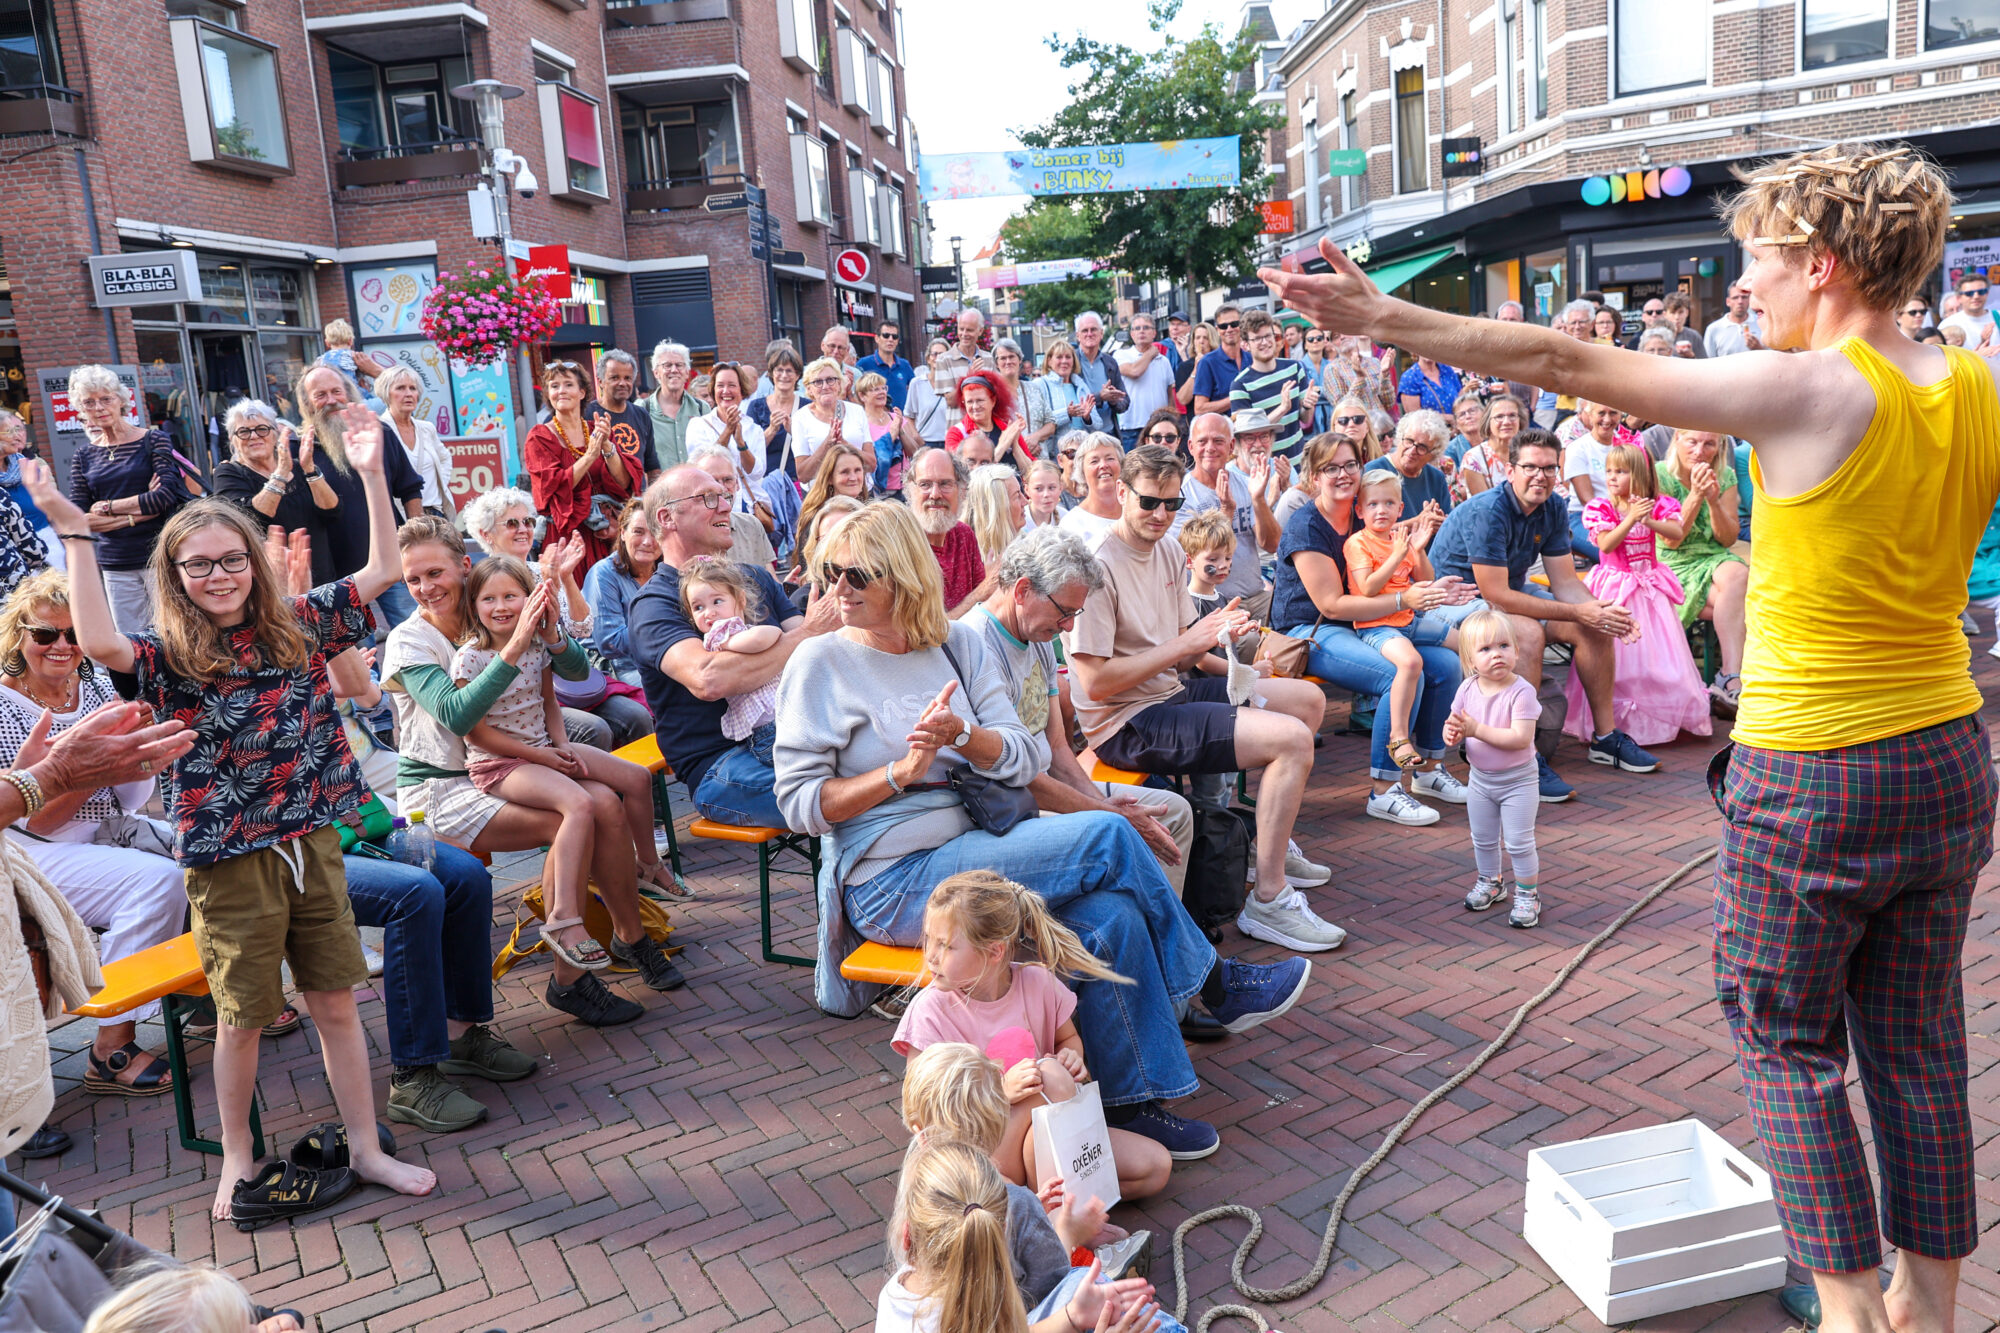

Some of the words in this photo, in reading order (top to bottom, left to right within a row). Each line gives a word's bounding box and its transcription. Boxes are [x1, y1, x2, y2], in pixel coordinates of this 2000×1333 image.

[1032, 152, 1090, 168] Zomer
[1097, 147, 1124, 168] bij
[104, 267, 173, 282] BLA-BLA
[521, 266, 566, 283] jamin
[105, 281, 176, 294] CLASSICS
[922, 283, 940, 291] GERRY
[447, 443, 498, 456] ORTING
[449, 465, 494, 495] 50
[1072, 1143, 1103, 1173] OXENER
[268, 1189, 300, 1202] FILA
